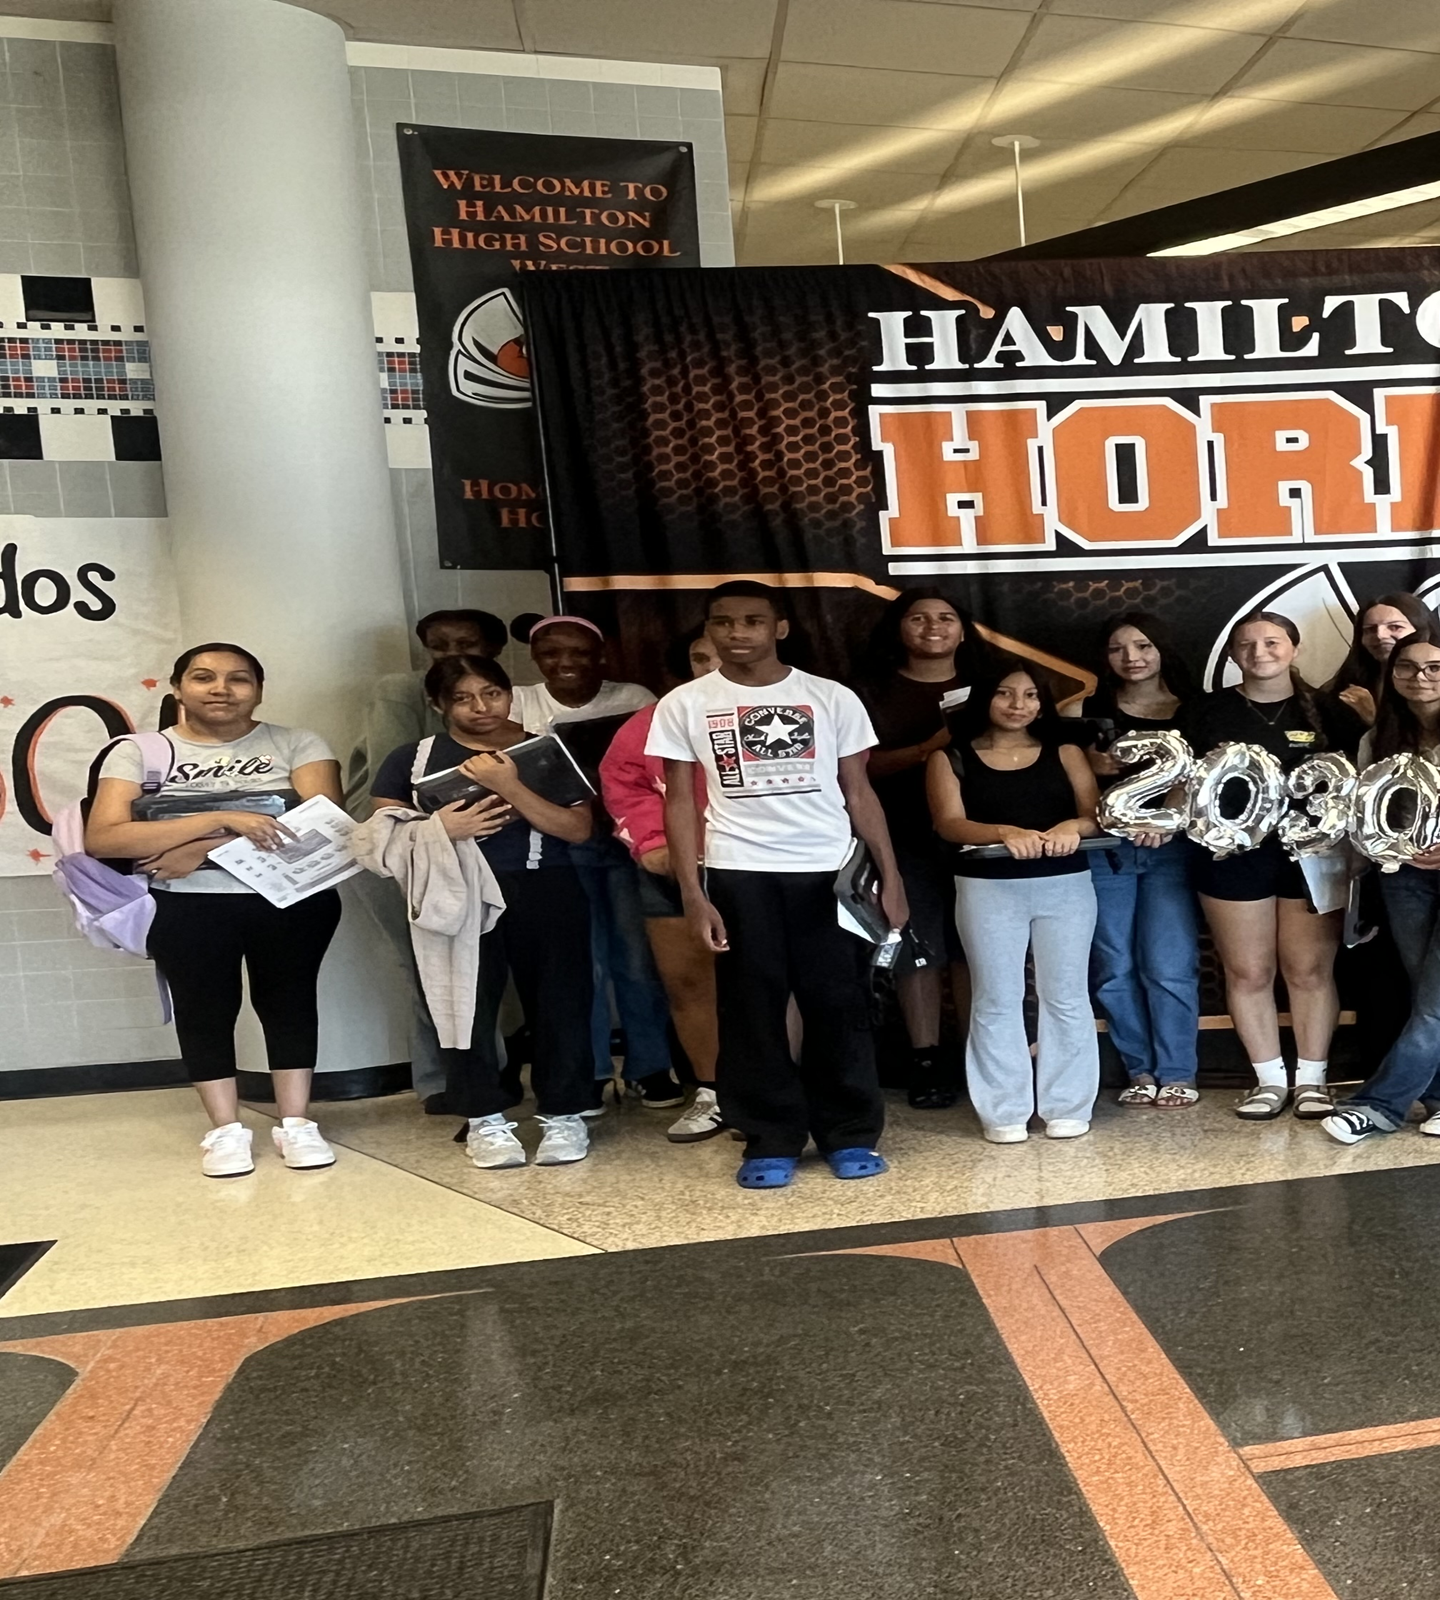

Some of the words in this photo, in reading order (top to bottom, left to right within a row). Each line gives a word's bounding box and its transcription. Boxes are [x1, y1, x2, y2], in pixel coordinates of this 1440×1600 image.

[432, 169, 613, 198] WELCOME
[620, 181, 668, 201] TO
[456, 199, 651, 229] HAMILTON
[431, 226, 529, 251] HIGH
[537, 231, 682, 257] SCHOOL
